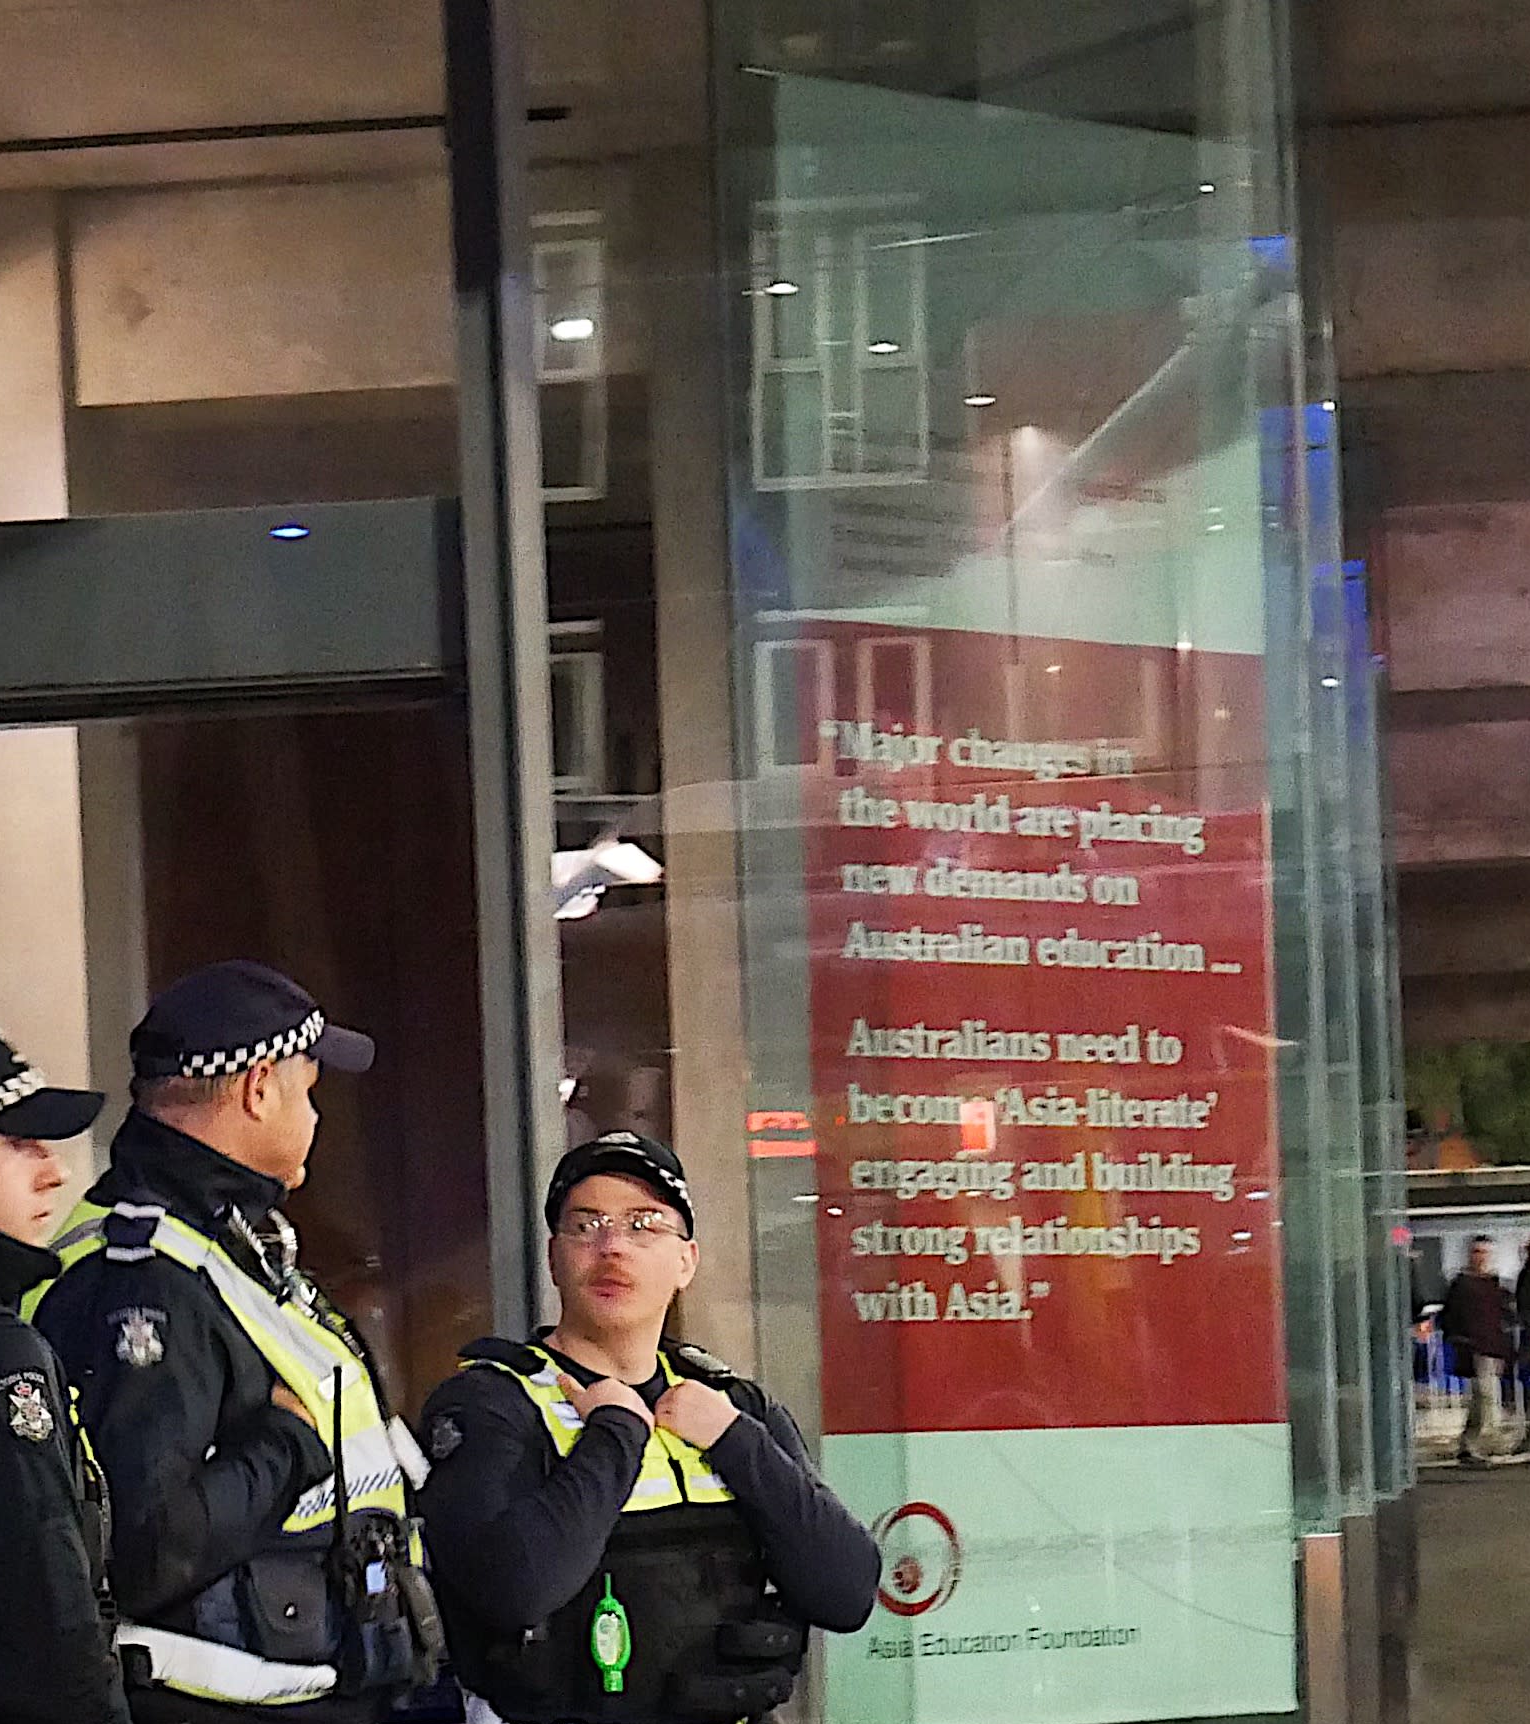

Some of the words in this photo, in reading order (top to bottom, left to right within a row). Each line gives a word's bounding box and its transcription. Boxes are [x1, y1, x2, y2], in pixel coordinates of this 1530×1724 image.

[949, 728, 1091, 779] changes
[1095, 740, 1134, 774] in
[840, 786, 897, 828] the
[903, 793, 1010, 834] world
[1015, 807, 1073, 838] are
[1078, 801, 1206, 855] placing
[841, 863, 918, 895] new
[923, 857, 1088, 904] demands
[1092, 875, 1141, 905] on
[841, 921, 1030, 965] Australian
[1036, 928, 1205, 972] education
[846, 1017, 1051, 1062] Australians
[1056, 1025, 1141, 1065] need
[1146, 1029, 1184, 1065] to
[850, 1150, 1016, 1200] engaging
[1021, 1151, 1087, 1191] and
[1091, 1151, 1237, 1201] building
[850, 1219, 970, 1265] strong
[974, 1215, 1201, 1265] relationships
[852, 1281, 939, 1322] with
[867, 1632, 914, 1660] Asia
[918, 1630, 1020, 1656] Education
[1025, 1624, 1142, 1650] Foundation
